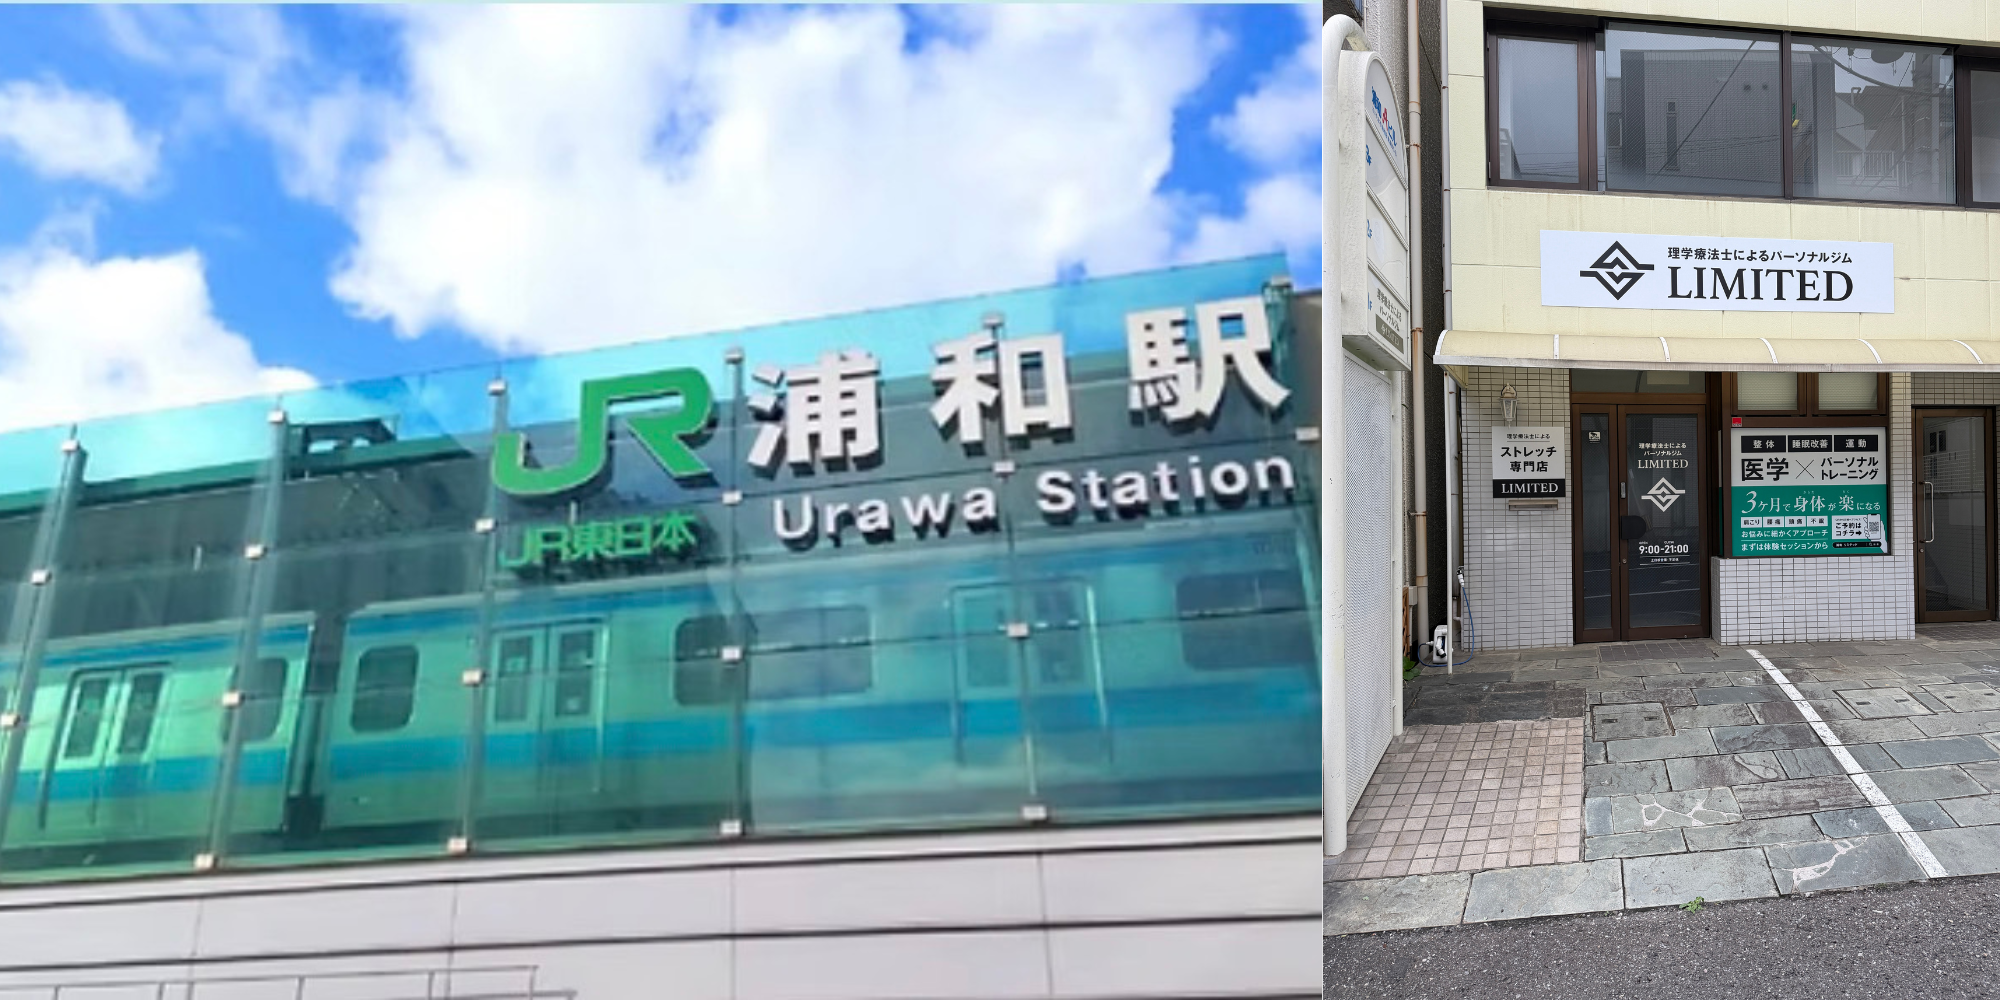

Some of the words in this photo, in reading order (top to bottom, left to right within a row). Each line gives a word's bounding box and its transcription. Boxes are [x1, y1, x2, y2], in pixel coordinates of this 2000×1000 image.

[1668, 247, 1852, 264] 理学療法士によるパーソナルジム
[1668, 266, 1853, 301] LIMITED
[491, 366, 713, 496] JR
[747, 296, 1291, 468] 浦和駅
[1753, 439, 1775, 448] 整体
[1792, 439, 1828, 448] 睡眠改善
[1845, 438, 1867, 448] 運動
[1501, 446, 1557, 457] ストレッチ
[1510, 461, 1548, 472] 専門店
[1638, 459, 1689, 469] LIMITED
[1741, 457, 1789, 481] 医学
[1821, 457, 1879, 467] パーソナル
[1821, 468, 1879, 480] トレーニング
[1501, 483, 1559, 494] LIMITED
[772, 480, 996, 543] Urawa
[1035, 455, 1293, 515] Station
[498, 511, 697, 568] JR東日本
[1639, 544, 1689, 554] 9:00-21:00
